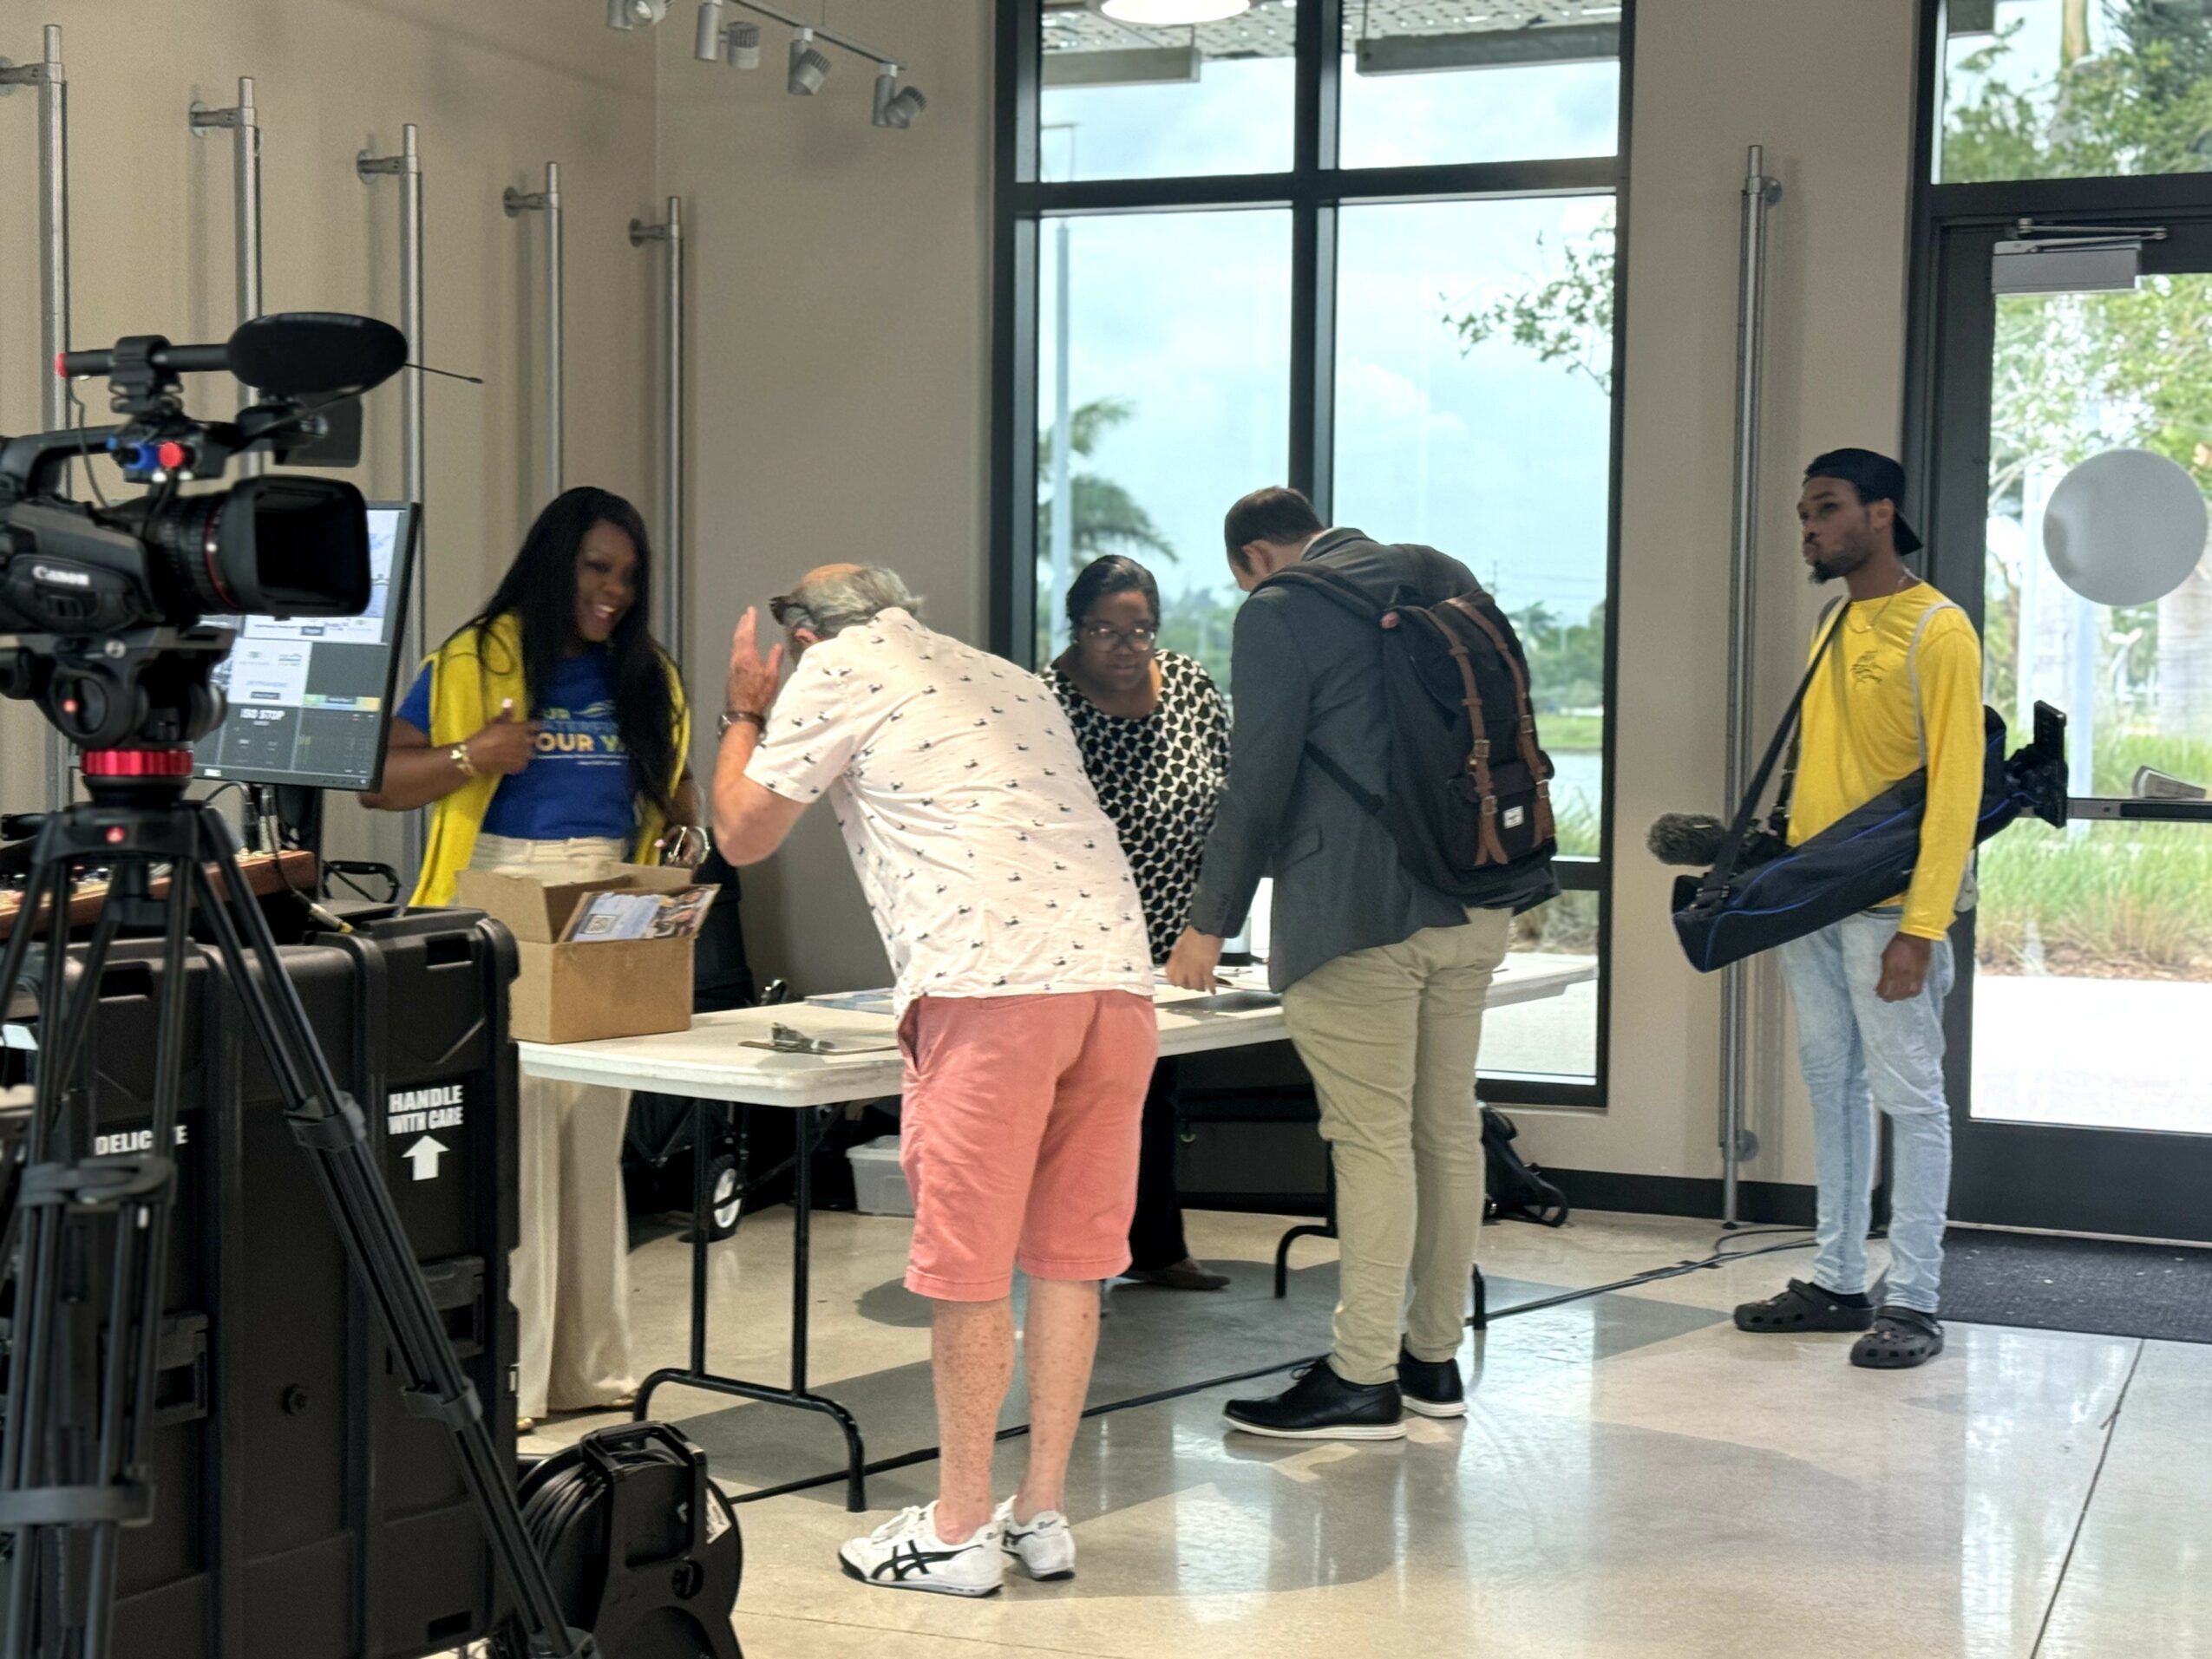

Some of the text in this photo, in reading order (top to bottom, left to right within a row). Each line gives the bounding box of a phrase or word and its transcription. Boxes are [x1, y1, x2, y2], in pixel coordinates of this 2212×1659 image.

[32, 565, 89, 585] Canon
[389, 1084, 464, 1114] HANDLE
[388, 1106, 464, 1135] WITH CARE
[95, 1125, 188, 1157] DELICE
